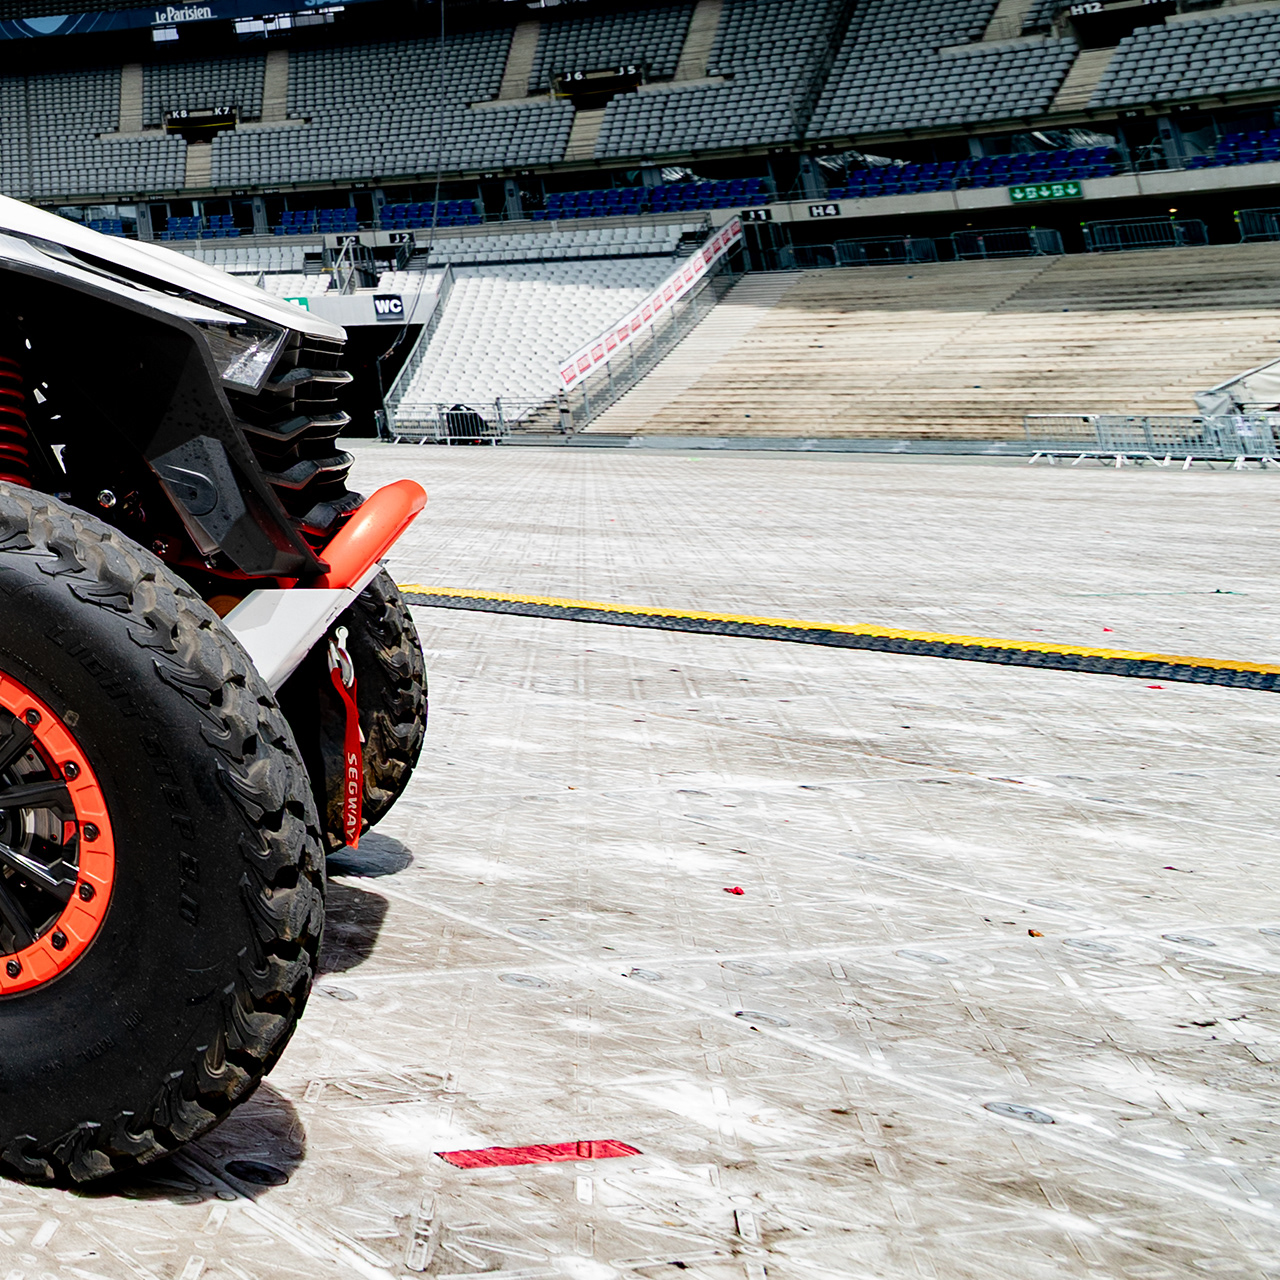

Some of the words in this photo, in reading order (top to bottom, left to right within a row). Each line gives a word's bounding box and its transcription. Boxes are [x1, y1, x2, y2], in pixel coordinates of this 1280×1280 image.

[166, 5, 212, 22] Parisien
[811, 205, 836, 218] H4
[374, 299, 402, 314] WC
[45, 624, 149, 721] LIGHT
[139, 733, 197, 842] STEP
[346, 751, 359, 840] SEGWAY
